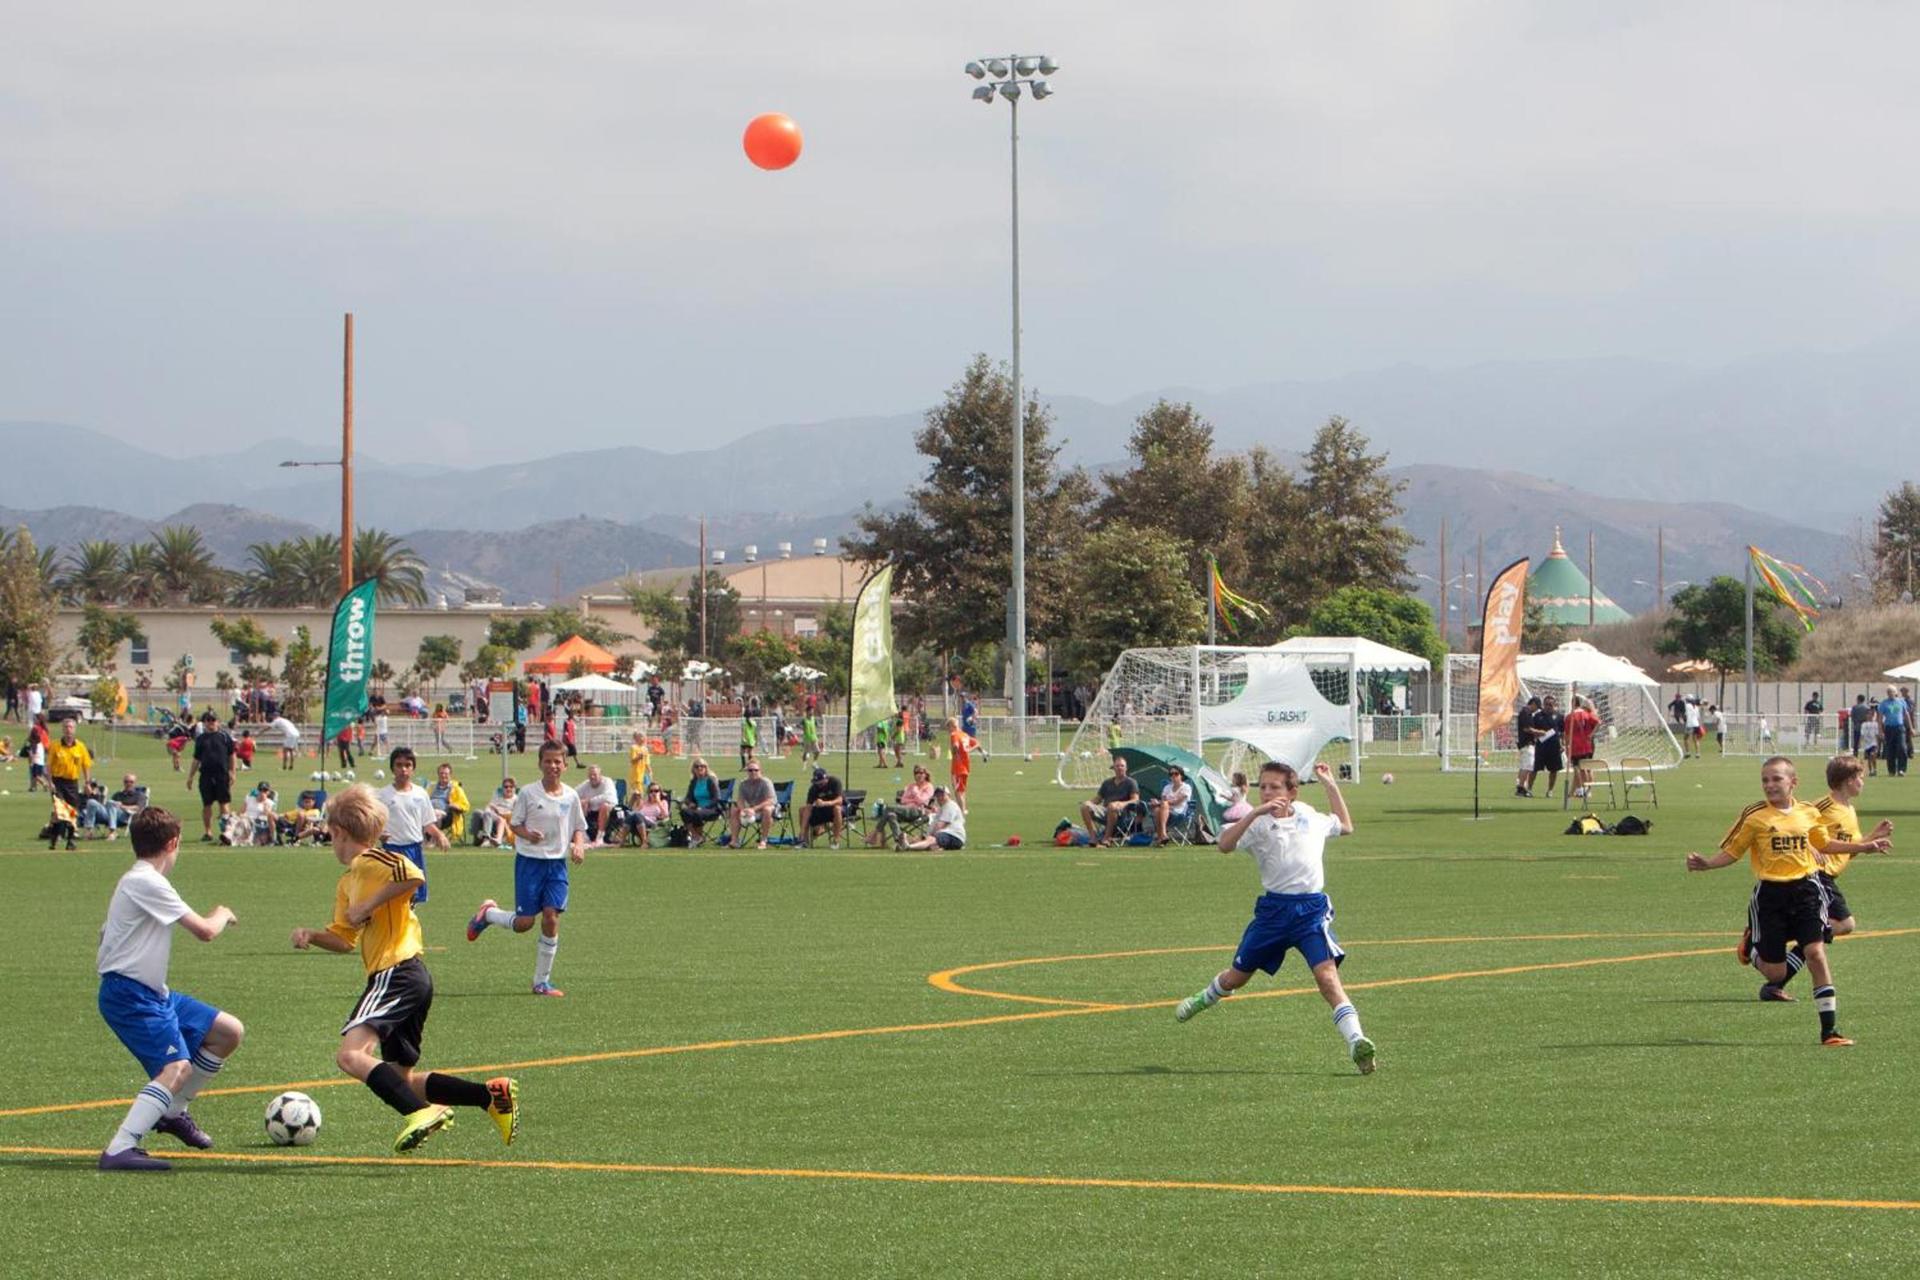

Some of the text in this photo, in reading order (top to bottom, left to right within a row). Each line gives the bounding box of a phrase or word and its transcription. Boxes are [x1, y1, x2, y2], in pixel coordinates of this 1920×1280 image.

[339, 597, 365, 683] throw
[1490, 582, 1519, 645] play
[1771, 836, 1807, 851] ELITE
